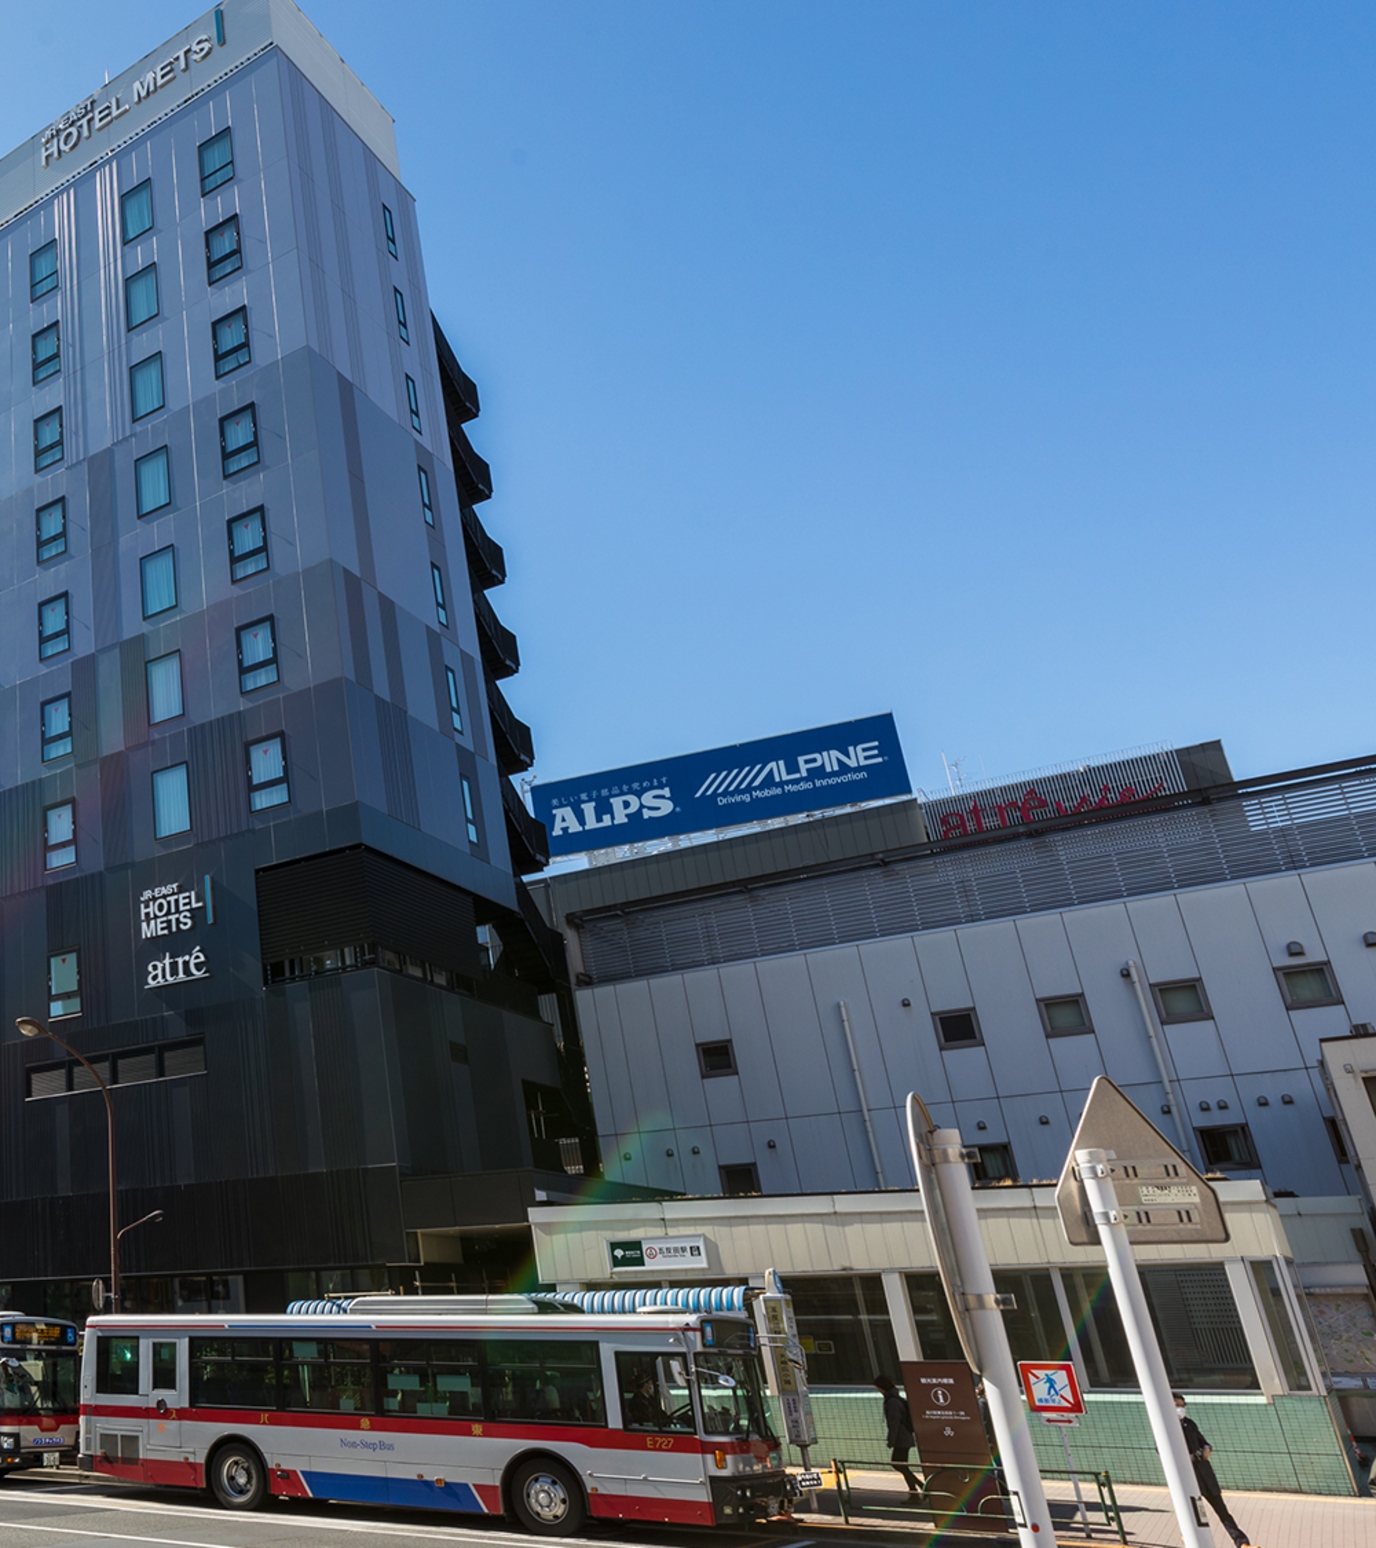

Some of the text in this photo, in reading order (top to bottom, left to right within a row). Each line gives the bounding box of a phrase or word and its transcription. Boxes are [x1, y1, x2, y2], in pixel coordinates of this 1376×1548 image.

[41, 34, 213, 168] HOTEL METS
[41, 98, 96, 145] JR-EAST
[751, 741, 884, 788] ALPINE
[717, 770, 868, 806] Driving Mobile Media Innovation
[551, 786, 674, 837] ALPS
[140, 883, 179, 901] JR-EAST
[140, 891, 204, 920] HOTEL
[141, 911, 193, 940] METS
[146, 945, 208, 987] atré
